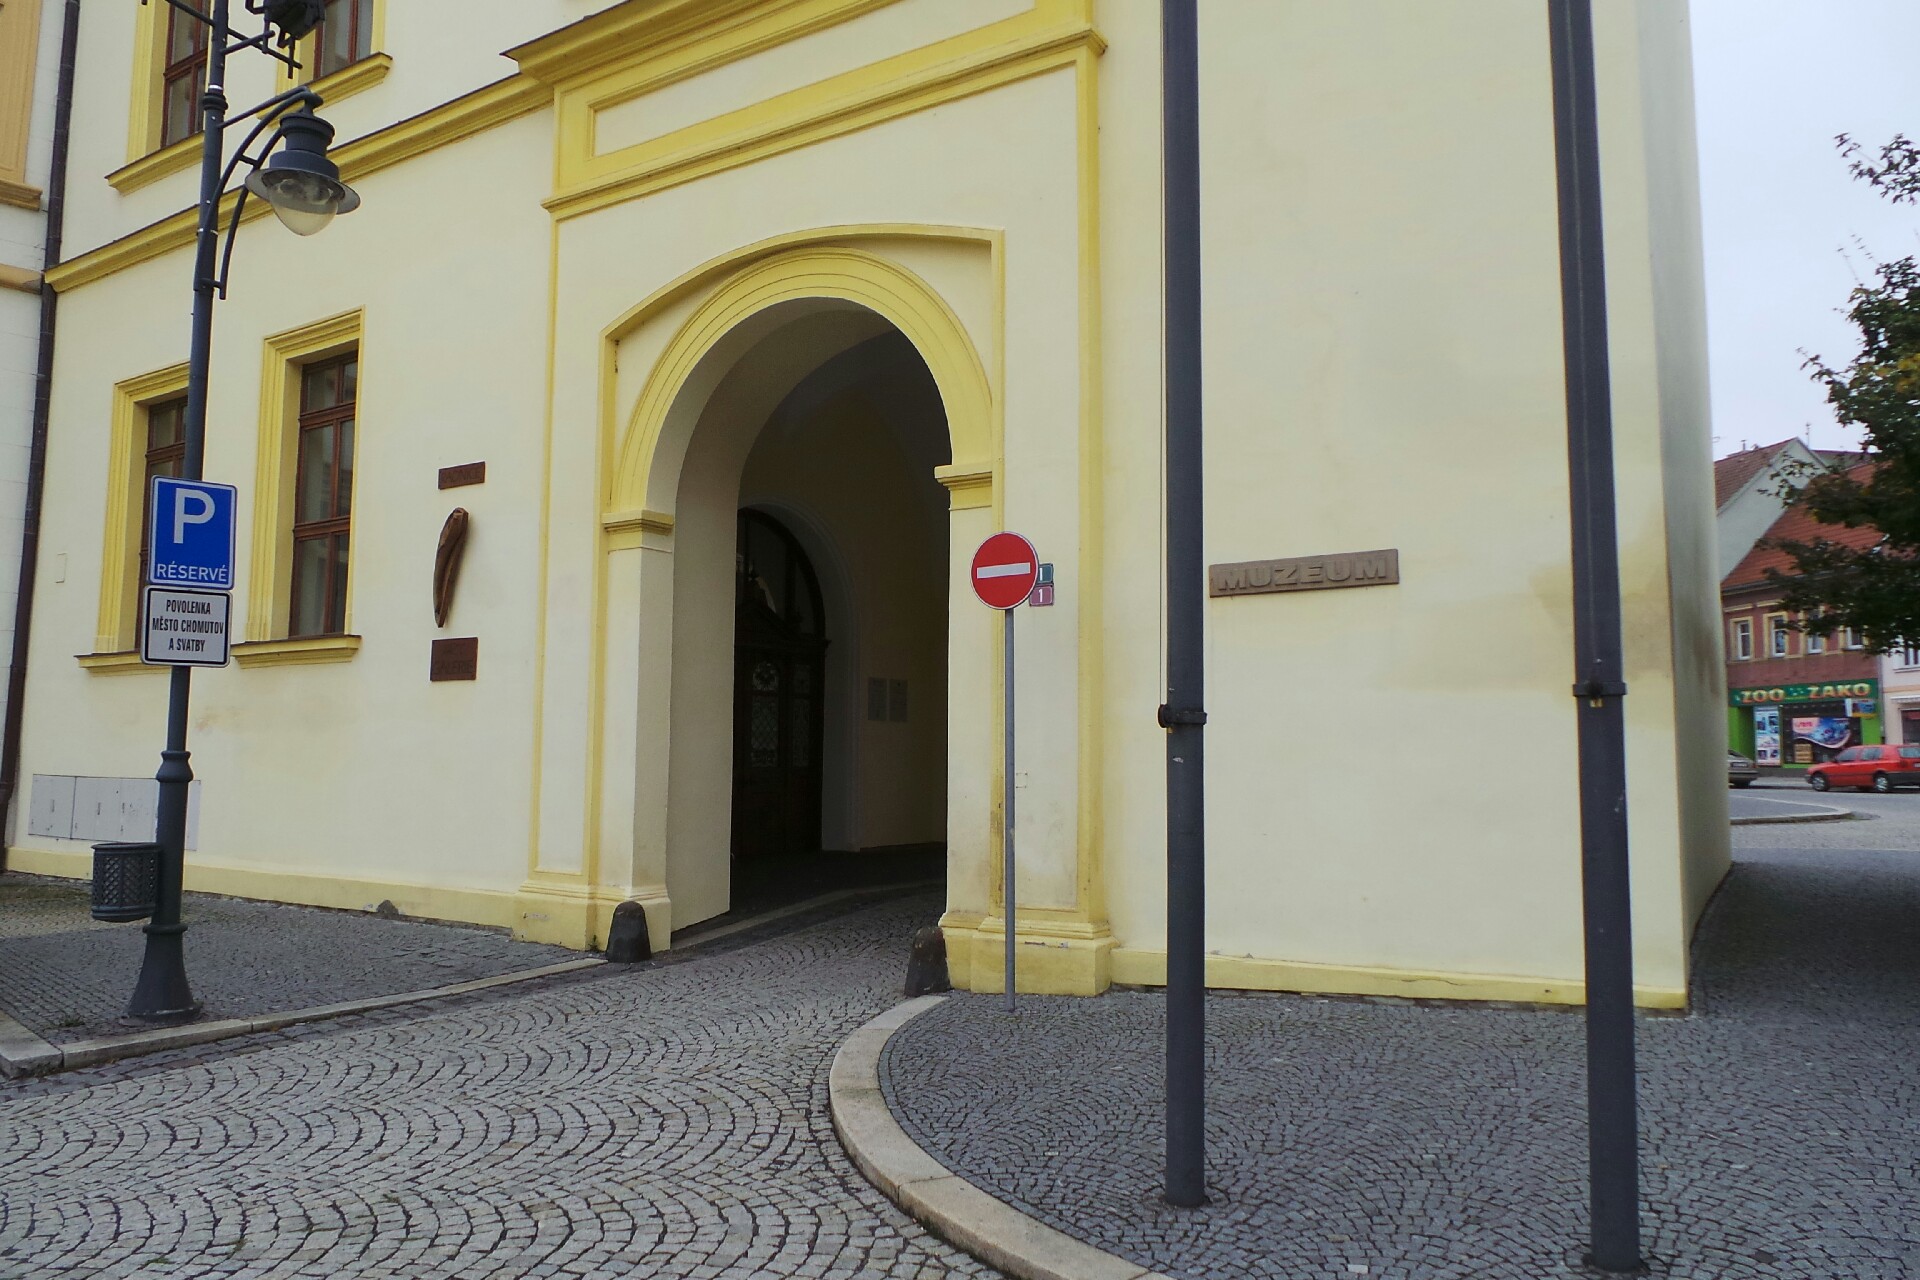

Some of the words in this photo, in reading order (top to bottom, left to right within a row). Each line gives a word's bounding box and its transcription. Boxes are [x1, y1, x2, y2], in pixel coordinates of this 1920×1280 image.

[173, 487, 216, 544] P
[156, 561, 228, 582] RÉSERVÉ
[1217, 556, 1387, 591] MUZEUM
[165, 599, 211, 615] POVOLENKA
[152, 616, 179, 632] MĚSTO
[180, 619, 224, 635] CHOMUTOV
[168, 637, 174, 651] A
[176, 638, 206, 653] SVATBY
[1741, 688, 1785, 704] ZOO
